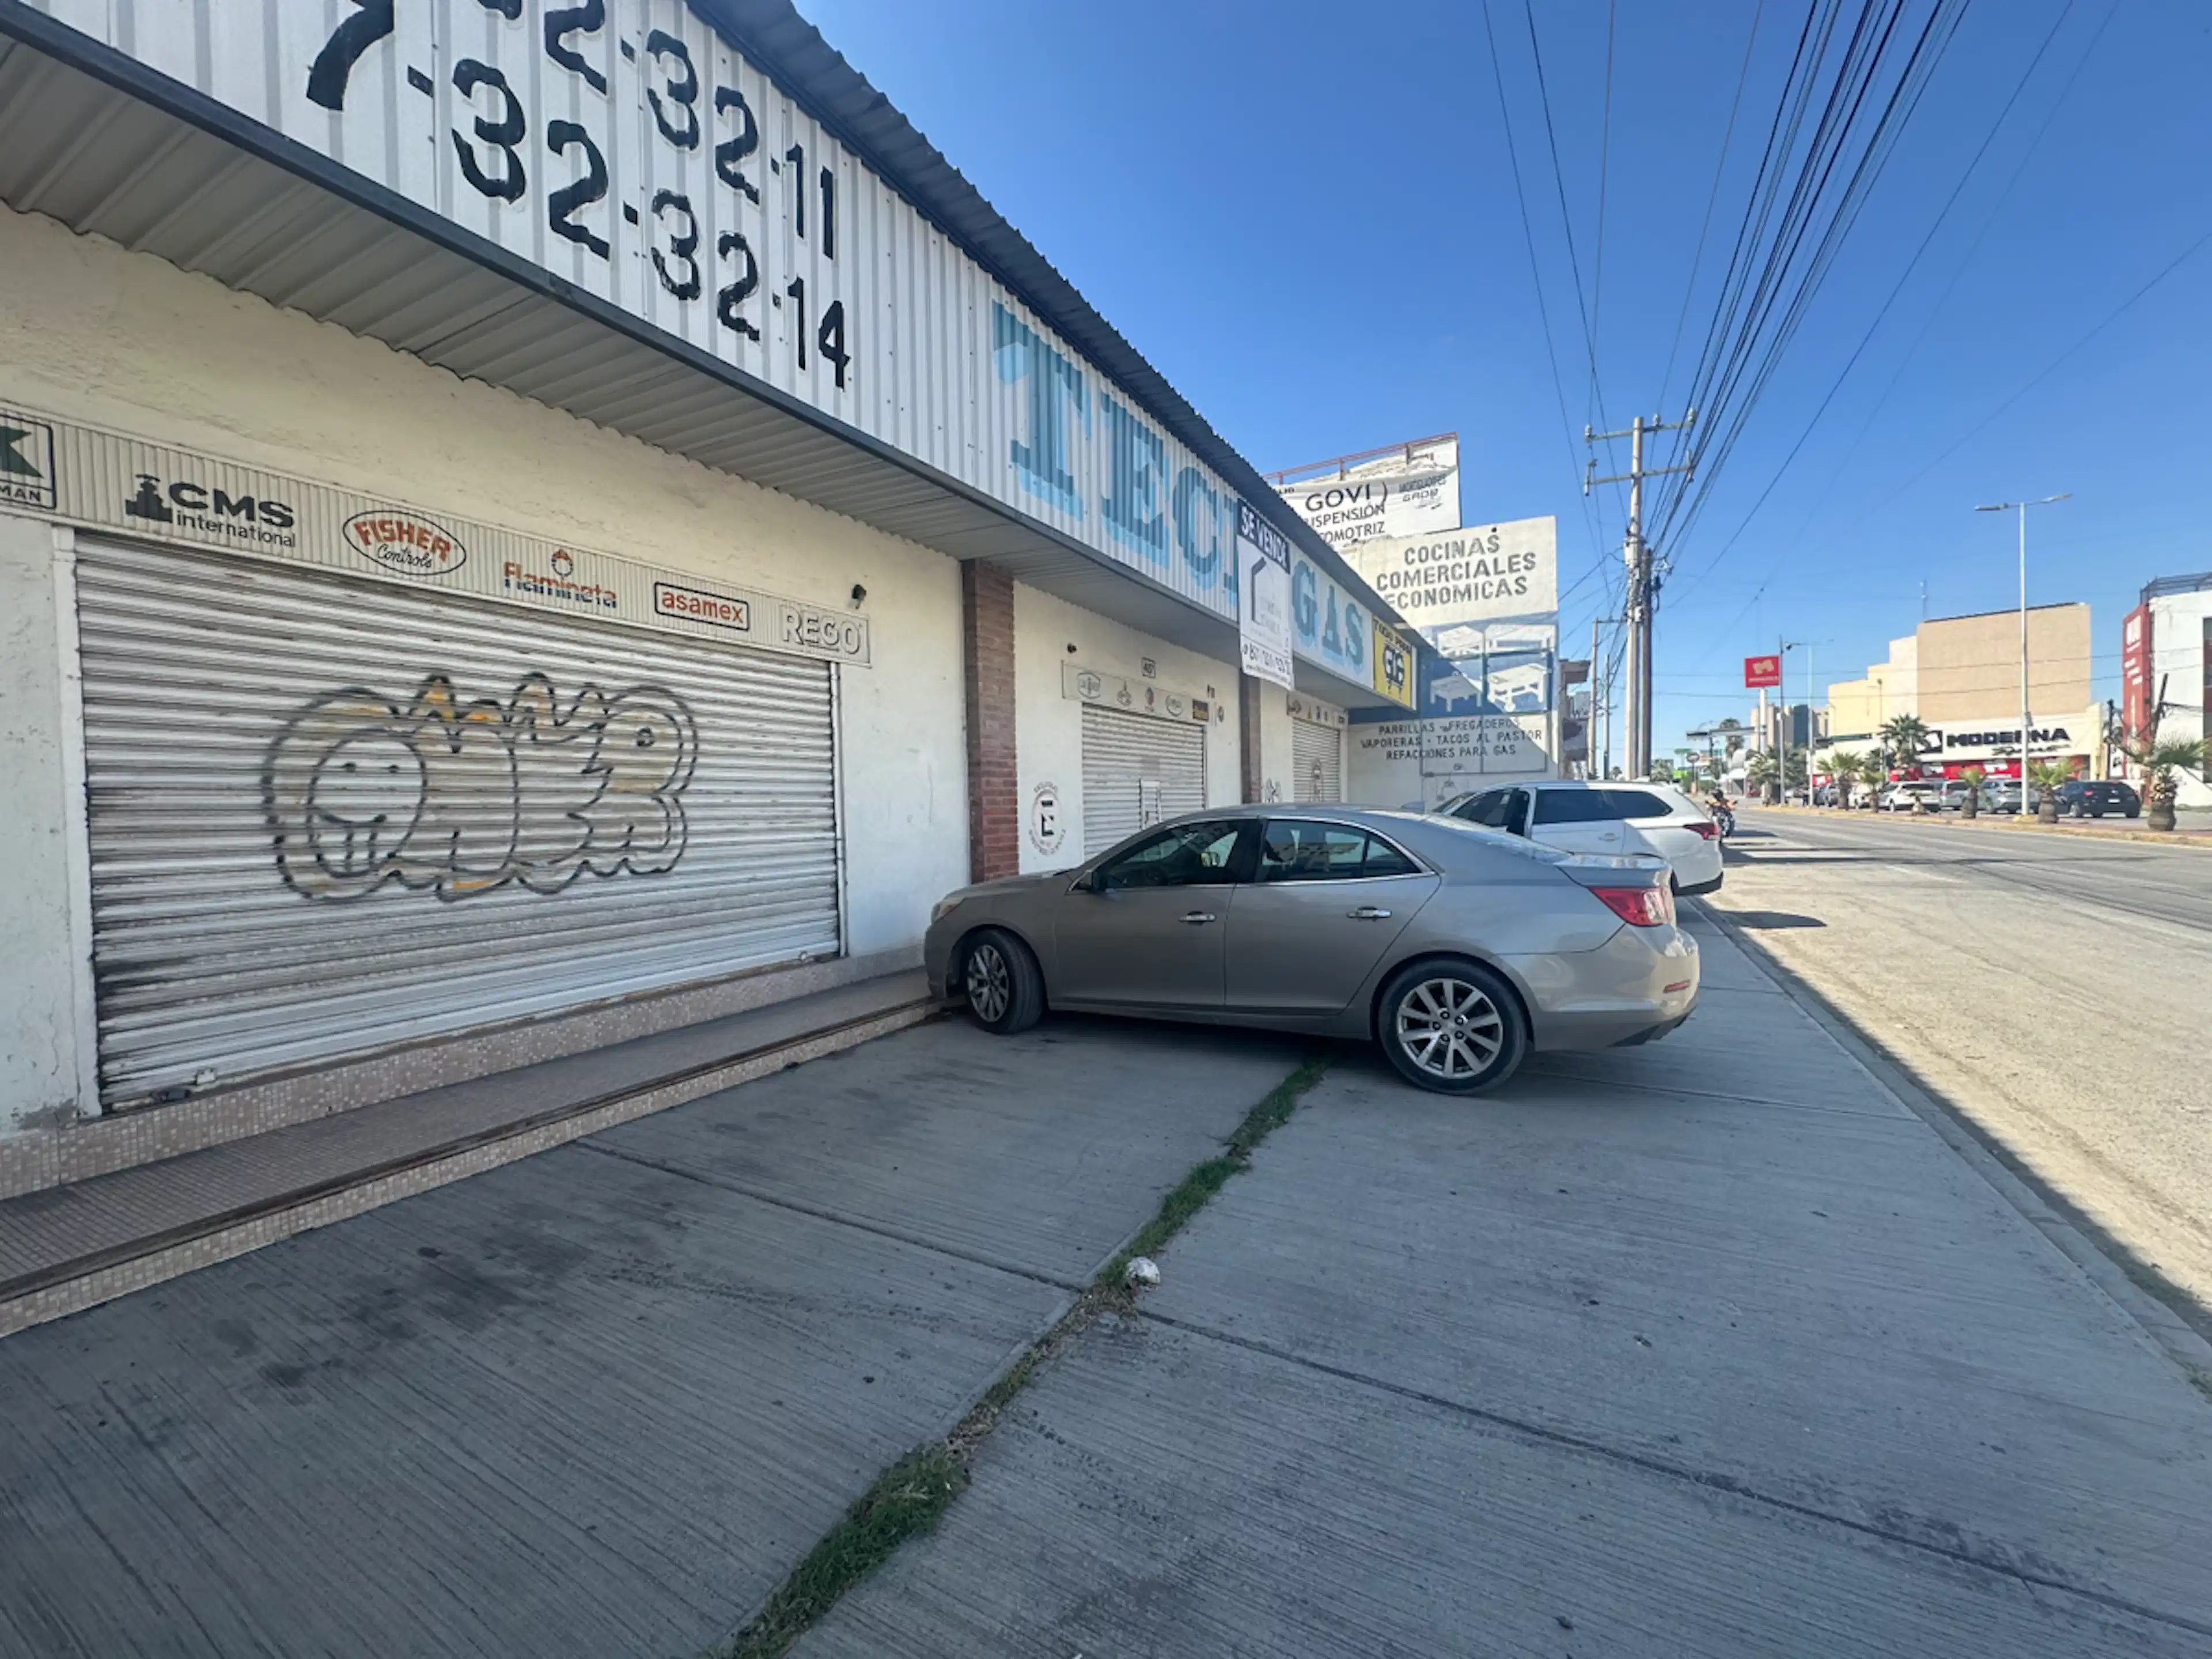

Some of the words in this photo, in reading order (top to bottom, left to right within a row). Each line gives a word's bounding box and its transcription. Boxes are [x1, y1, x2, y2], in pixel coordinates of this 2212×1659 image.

[169, 482, 294, 528] CMS
[1305, 483, 1371, 512] GOVI
[176, 510, 296, 547] international
[353, 520, 452, 562] FISHER
[377, 543, 432, 568] Controls
[1404, 534, 1501, 566] COCINAS
[1376, 552, 1536, 592] COMERCIALES
[661, 590, 744, 624] asamex
[1292, 559, 1365, 669] GAS
[781, 605, 861, 655] REGO
[1378, 722, 1435, 736] PARRILLAS
[1435, 733, 1469, 745] TACOS
[1476, 733, 1491, 743] AL
[1496, 730, 1541, 742] PASTOR
[1459, 745, 1487, 756] PARA
[1493, 744, 1516, 756] GAS
